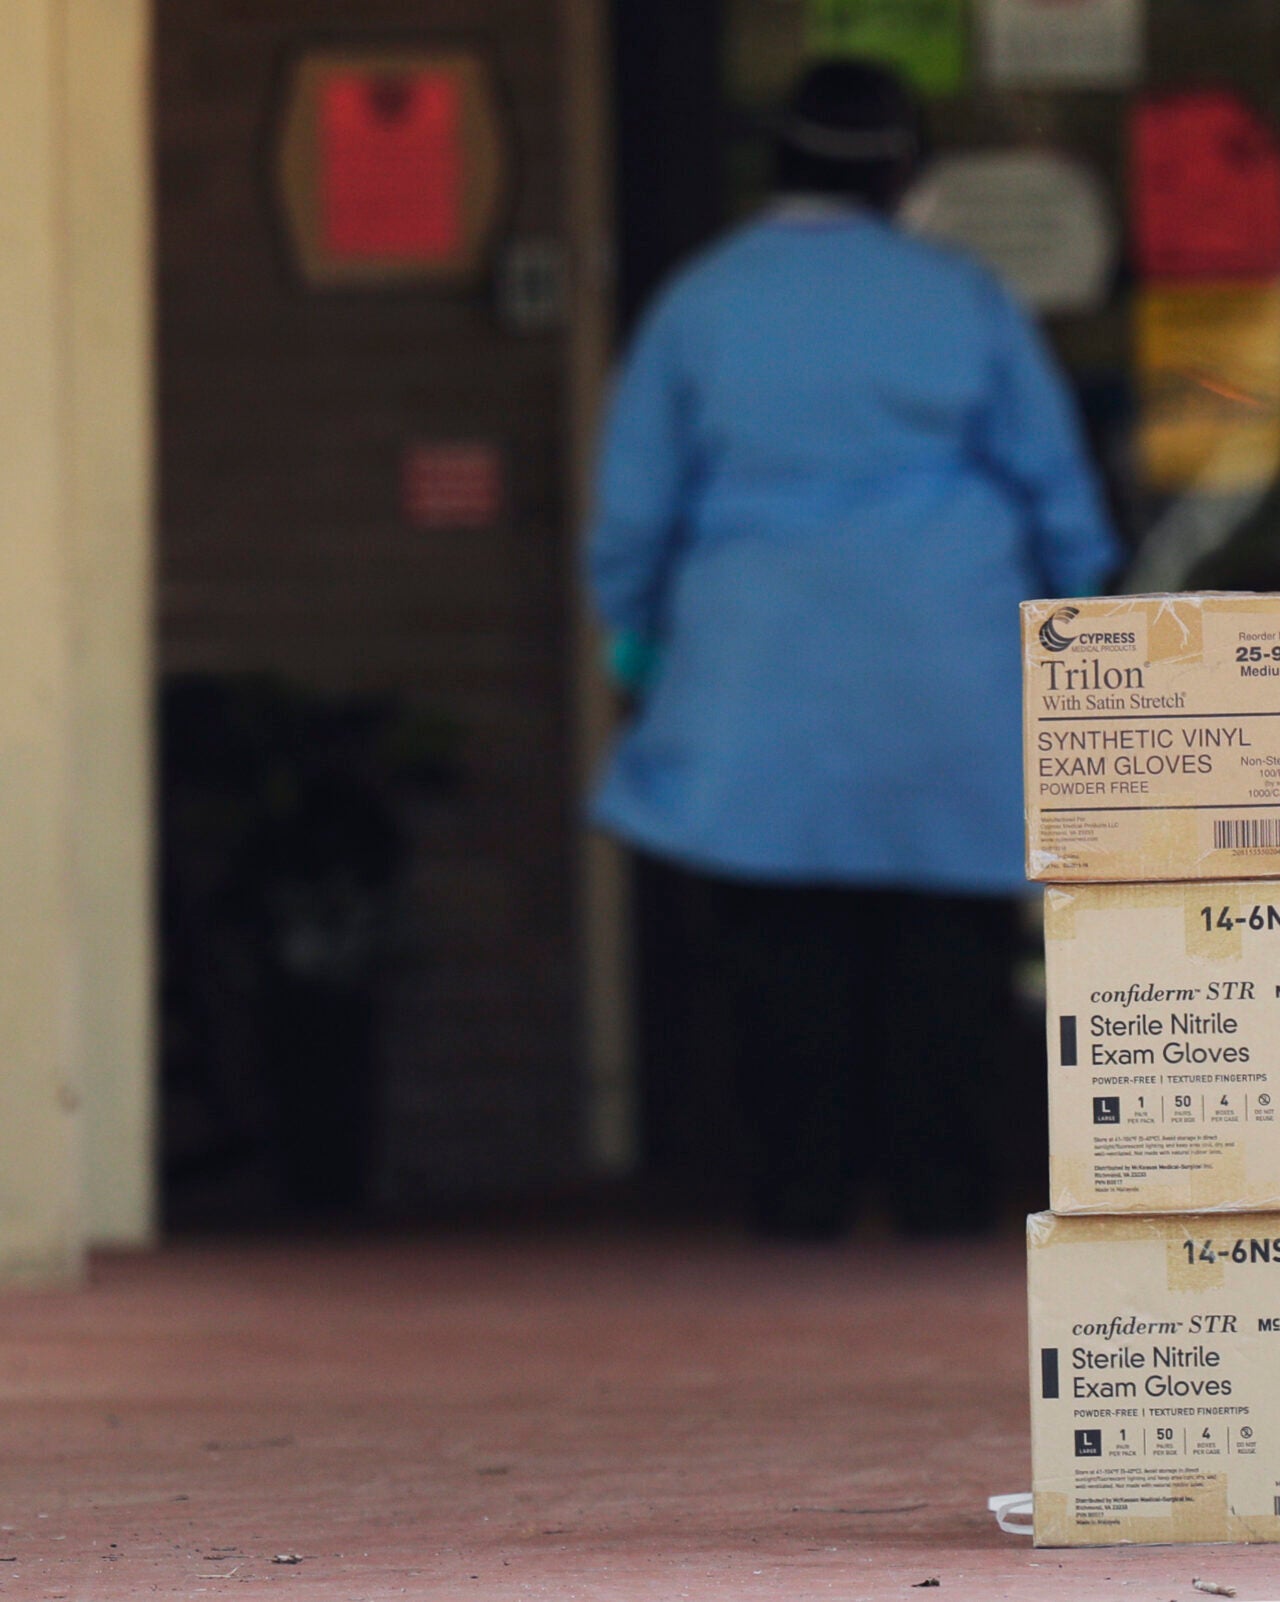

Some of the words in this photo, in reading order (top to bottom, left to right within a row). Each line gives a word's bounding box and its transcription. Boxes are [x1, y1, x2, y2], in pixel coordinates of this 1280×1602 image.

[1079, 632, 1135, 645] CYPRESS
[1238, 632, 1276, 641] Reorder
[1071, 645, 1100, 653] MEDICAL
[1100, 644, 1136, 652] PRODUCTS
[1040, 658, 1144, 690] Trilon
[1042, 695, 1081, 711] With
[1086, 694, 1125, 710] Satin
[1130, 692, 1186, 709] Stretch
[1038, 729, 1173, 751] SYNTHETIC
[1182, 728, 1251, 748] VINYL
[1039, 757, 1105, 777] EXAM
[1114, 754, 1212, 776] GLOVES
[1040, 782, 1106, 795] POWDER
[1110, 781, 1149, 794] FREE
[1090, 983, 1197, 1008] confiderm
[1206, 981, 1255, 1000] STR
[1091, 1014, 1163, 1037] Sterile
[1171, 1012, 1238, 1035] Nitrile
[1092, 1044, 1154, 1065] Exam
[1163, 1042, 1250, 1064] Gloves
[1092, 1075, 1156, 1085] POWDER-FREE
[1167, 1074, 1213, 1084] TEXTURED
[1215, 1073, 1267, 1082] FINGERTIPS
[1175, 1095, 1191, 1107] 50
[1072, 1316, 1179, 1341] confiderm
[1189, 1315, 1237, 1334] STR
[1072, 1347, 1145, 1369] Sterile
[1153, 1345, 1220, 1368] Nitrile
[1073, 1377, 1136, 1398] Exam
[1145, 1375, 1232, 1397] Gloves
[1074, 1408, 1138, 1418] POWDER-FREE
[1149, 1407, 1195, 1416] TEXTURED
[1197, 1406, 1249, 1415] FINGERTIPS
[1157, 1428, 1173, 1440] 50
